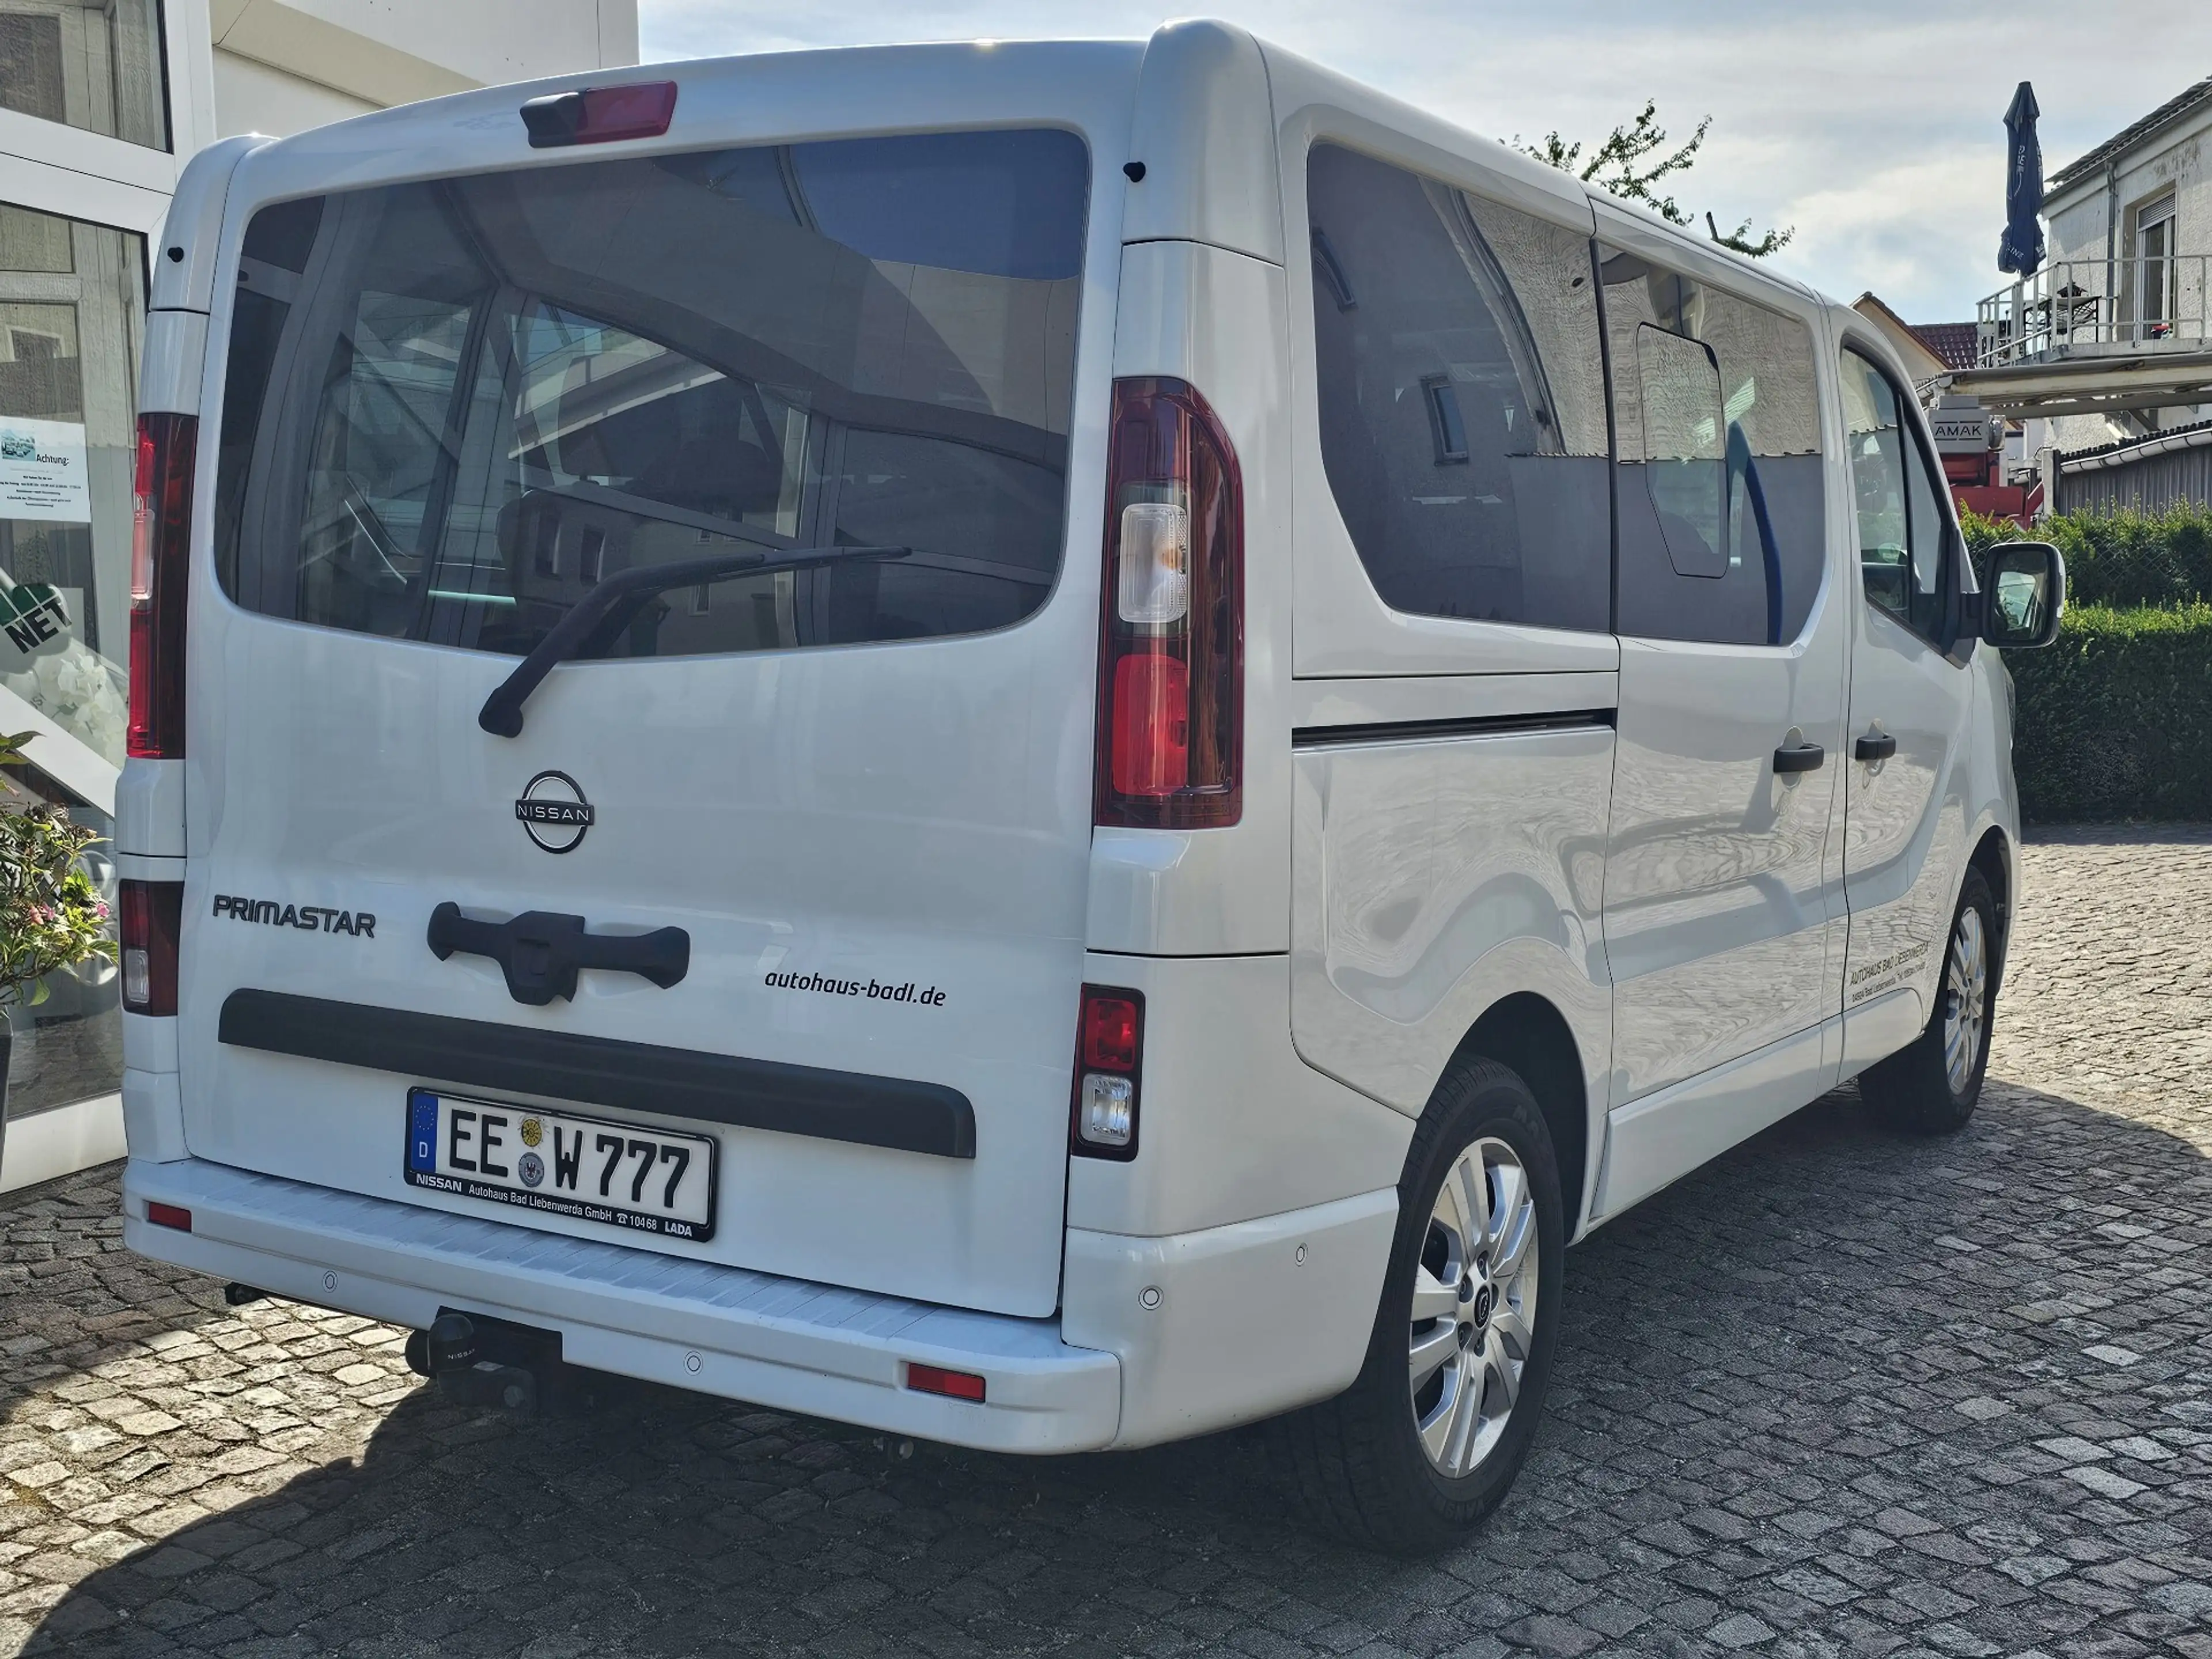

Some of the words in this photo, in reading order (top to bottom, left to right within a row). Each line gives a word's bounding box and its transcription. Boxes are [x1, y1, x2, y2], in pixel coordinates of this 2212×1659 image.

[1935, 425, 1982, 436] AMAK
[518, 805, 589, 821] NISSAN
[213, 894, 376, 938] PRIMASTAR
[764, 972, 946, 1007] autohaus-badl.de
[419, 1141, 428, 1158] D
[449, 1108, 509, 1178] EE
[416, 1173, 462, 1192] NISSAN
[469, 1184, 508, 1202] Autohaus
[510, 1192, 527, 1204] Bad
[529, 1194, 582, 1215] Liebenwerda
[585, 1206, 612, 1221] GmbH
[665, 1221, 692, 1237] LADA
